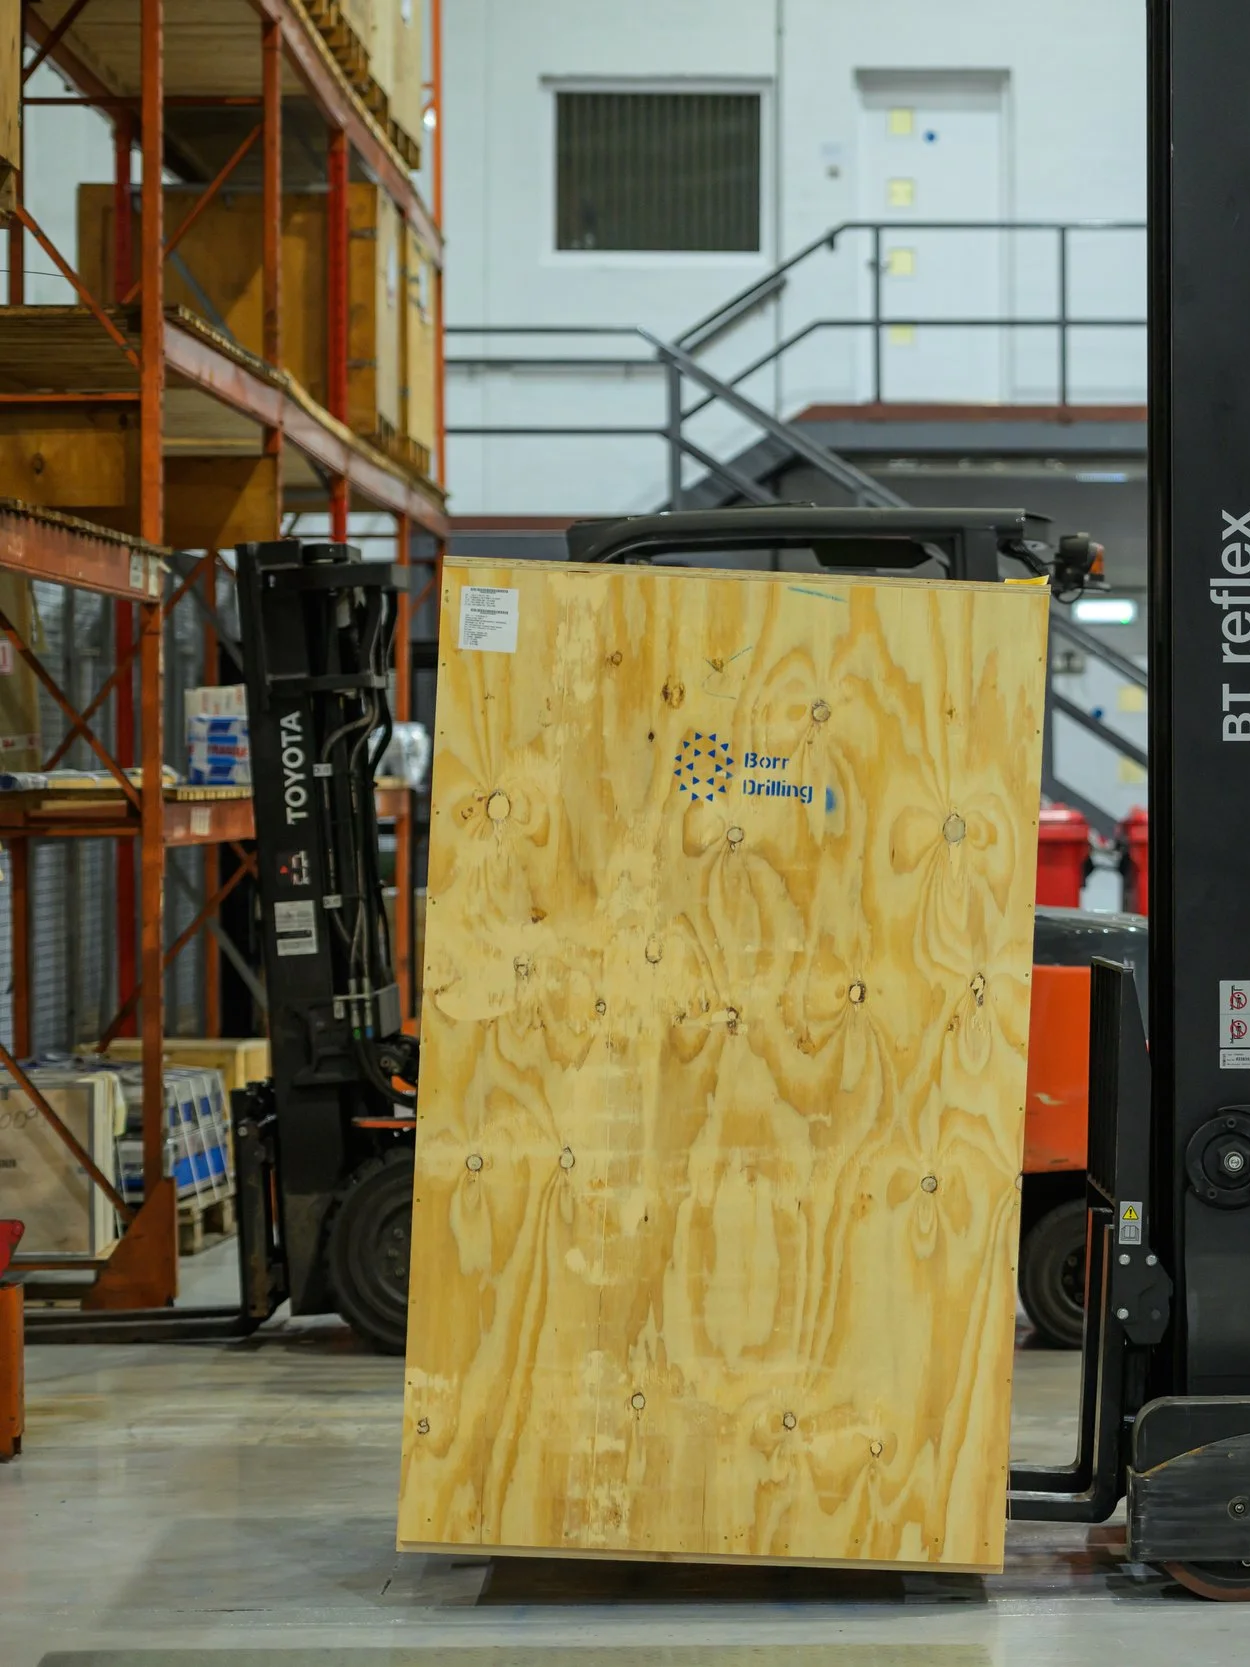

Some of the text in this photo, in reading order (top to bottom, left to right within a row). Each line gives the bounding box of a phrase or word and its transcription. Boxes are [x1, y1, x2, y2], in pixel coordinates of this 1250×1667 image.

[279, 710, 309, 825] TOYOTA
[744, 752, 790, 770] Borr
[743, 779, 813, 804] Drilling
